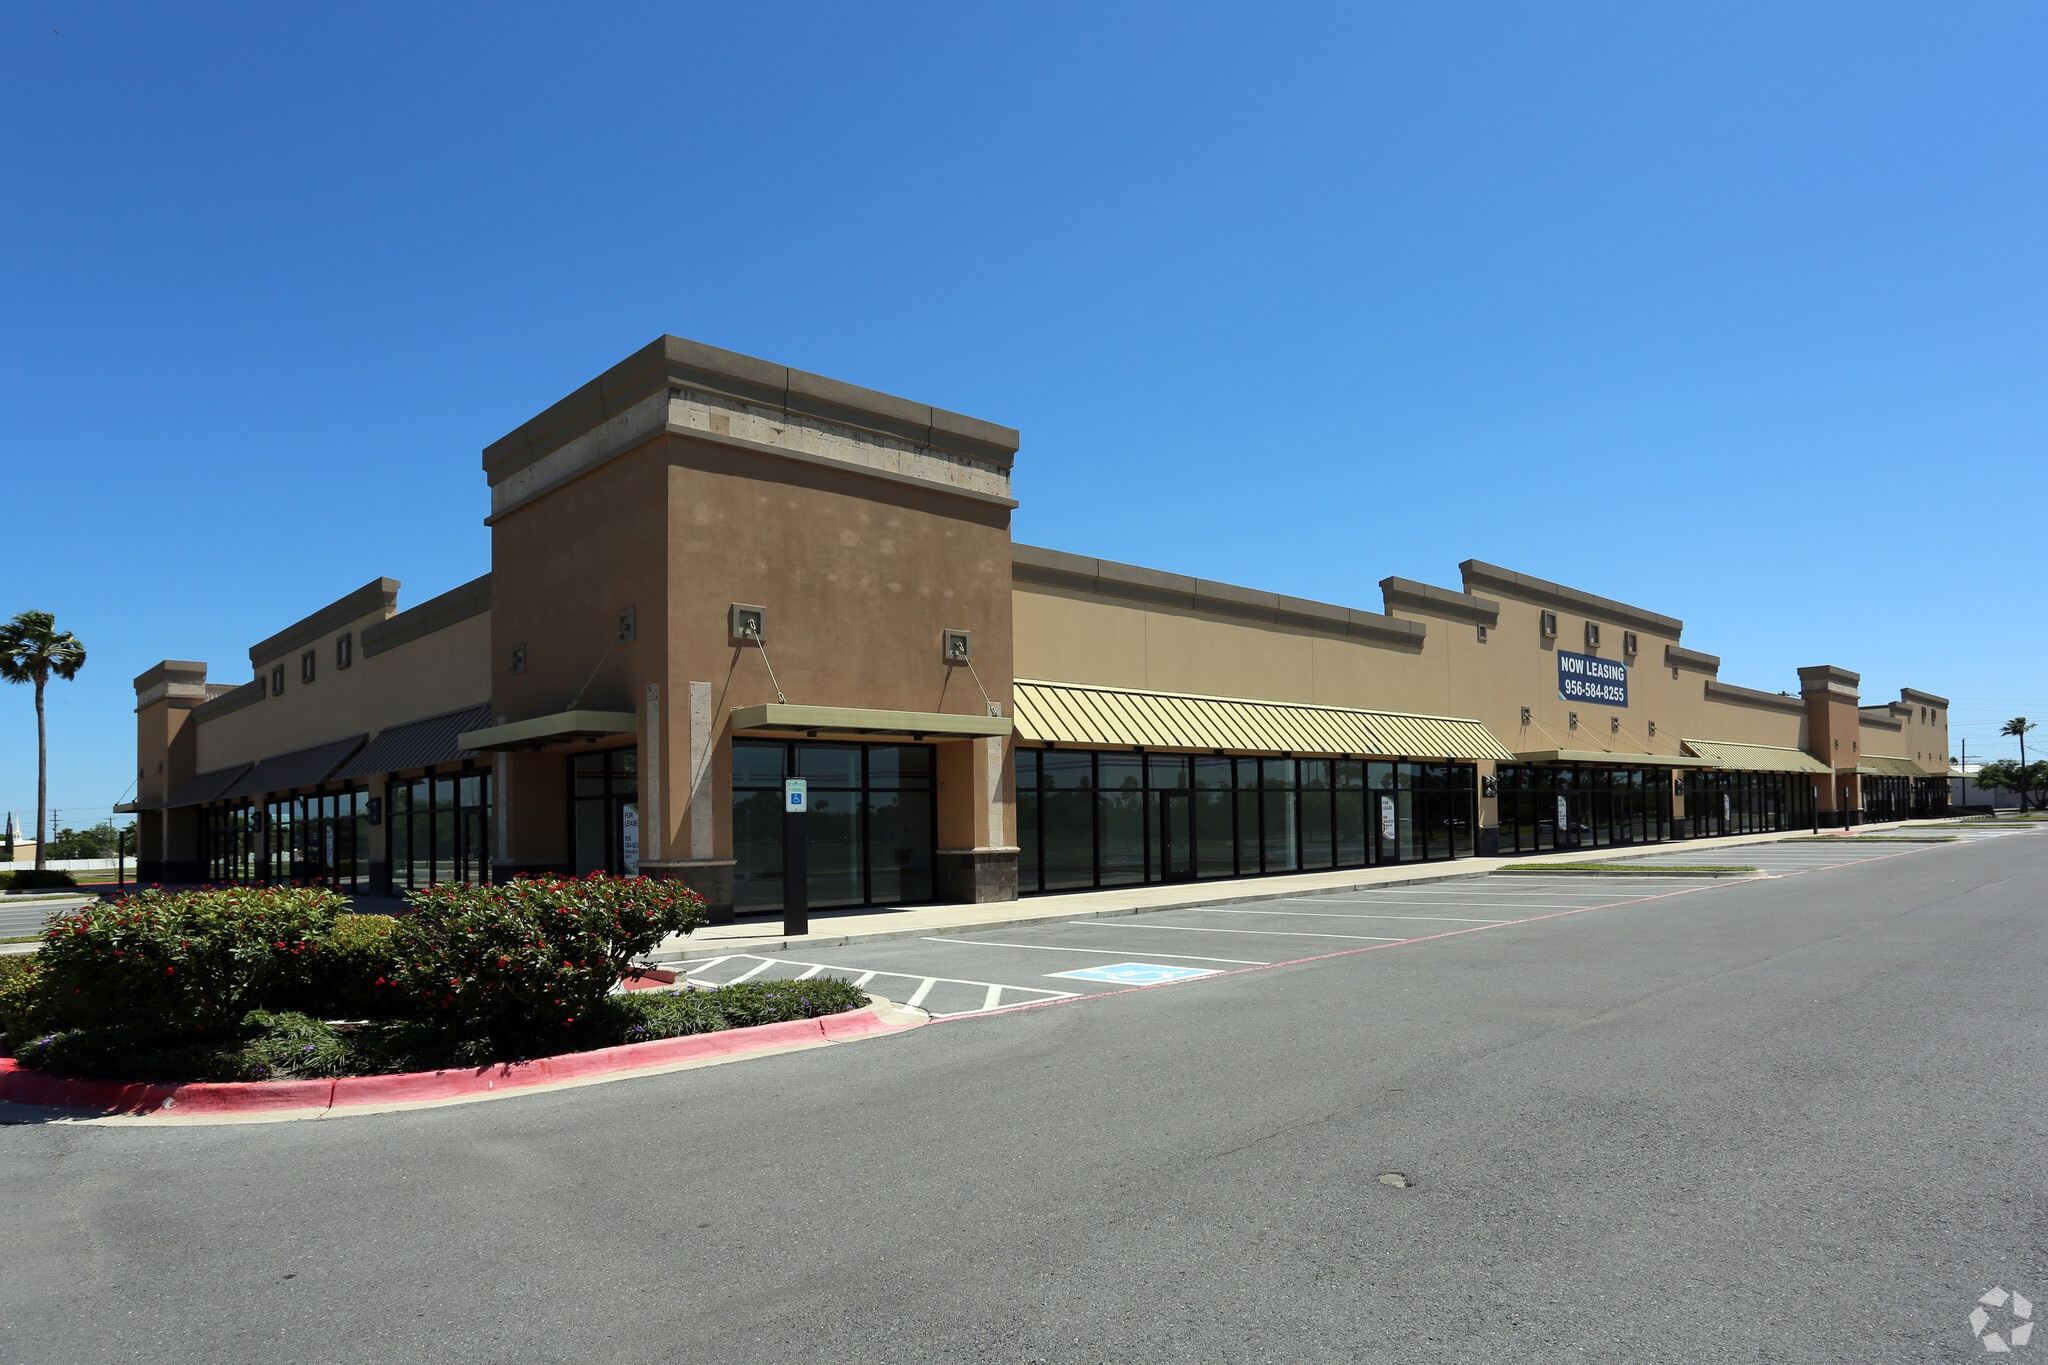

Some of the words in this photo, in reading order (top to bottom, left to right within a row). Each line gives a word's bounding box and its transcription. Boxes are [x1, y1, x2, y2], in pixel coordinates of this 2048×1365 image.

[1561, 656, 1584, 675] NOW
[1586, 661, 1625, 681] LEASING
[1565, 679, 1624, 702] 956-584-8255
